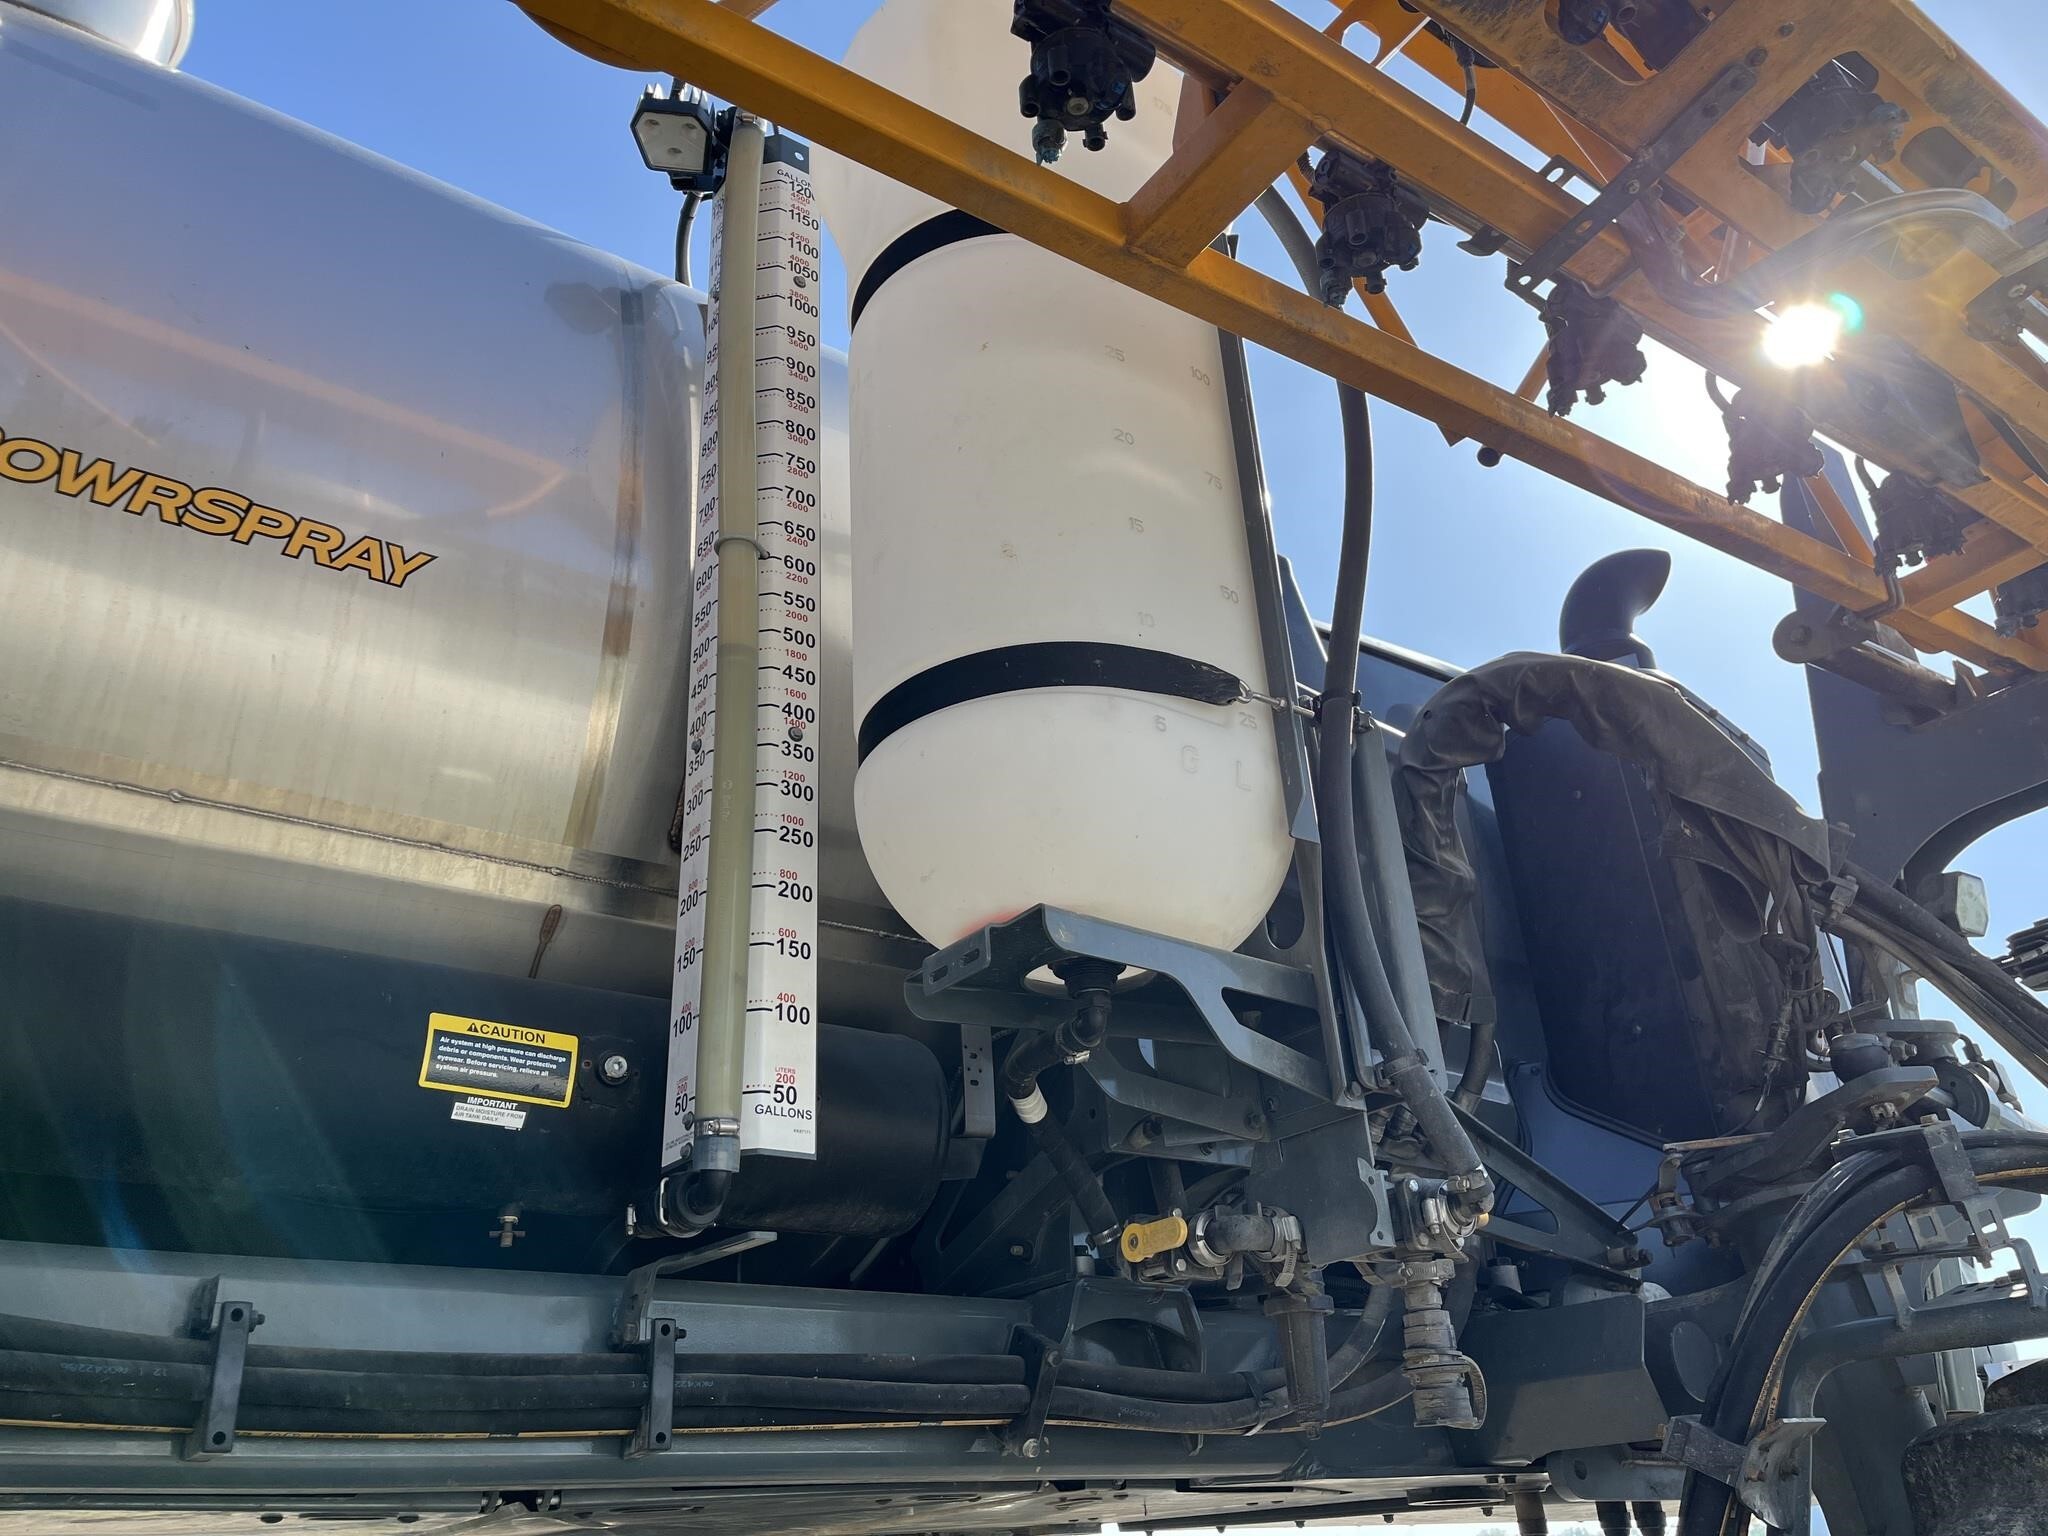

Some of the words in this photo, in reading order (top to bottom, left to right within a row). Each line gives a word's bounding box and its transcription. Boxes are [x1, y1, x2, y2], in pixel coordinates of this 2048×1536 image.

[789, 210, 819, 230] 1150
[788, 238, 818, 259] 1100
[790, 232, 810, 244] 4200
[788, 261, 818, 282] 1050
[789, 289, 809, 302] 3800
[787, 296, 818, 318] 1000
[786, 326, 816, 347] 950
[788, 338, 808, 351] 3600
[786, 357, 816, 378] 900
[788, 370, 808, 382] 3400
[786, 388, 816, 409] 850
[788, 401, 808, 414] 3200
[786, 420, 816, 441] 800
[788, 433, 808, 446] 3000
[1112, 428, 1136, 446] 20
[786, 452, 816, 474] 750
[787, 466, 808, 479] 2800
[700, 464, 716, 489] 750
[0, 425, 438, 588] OWRSPRAY
[785, 486, 816, 508] 700
[786, 500, 808, 512] 2600
[699, 497, 715, 523] 700
[784, 521, 816, 542] 650
[1128, 516, 1144, 535] 15
[698, 531, 714, 557] 650
[786, 534, 808, 548] 2400
[784, 555, 816, 576] 600
[696, 565, 712, 592] 600
[786, 572, 808, 584] 2200
[784, 591, 816, 612] 550
[694, 601, 712, 628] 550
[786, 610, 808, 622] 2000
[783, 627, 816, 648] 500
[693, 637, 710, 664] 500
[785, 649, 807, 662] 1800
[782, 665, 816, 686] 450
[691, 674, 708, 699] 450
[784, 688, 807, 700] 1600
[690, 711, 706, 736] 400
[782, 702, 815, 724] 400
[784, 717, 806, 730] 1400
[781, 741, 814, 762] 350
[688, 750, 706, 776] 350
[783, 770, 806, 783] 1200
[780, 780, 814, 802] 300
[686, 789, 704, 816] 300
[781, 814, 804, 826] 1000
[779, 826, 814, 848] 250
[683, 834, 701, 862] 250
[780, 869, 798, 880] 800
[778, 880, 812, 902] 200
[680, 890, 698, 918] 200
[778, 928, 796, 939] 600
[776, 938, 812, 960] 150
[676, 947, 696, 973] 150
[776, 992, 796, 1004] 400
[775, 1003, 810, 1025] 100
[480, 1024, 546, 1044] CAUTION
[673, 1012, 692, 1038] 100
[438, 1046, 460, 1054] debris
[526, 1060, 556, 1069] protective
[451, 1038, 474, 1046] system
[497, 1046, 524, 1056] pressure
[537, 1052, 566, 1062] discharge
[436, 1064, 459, 1072] system
[466, 1058, 488, 1066] Before
[776, 1074, 796, 1085] 200
[467, 1096, 518, 1110] IMPORTANT
[674, 1093, 688, 1116] 50
[773, 1085, 797, 1105] 50
[475, 1108, 505, 1116] MOISTURE
[754, 1104, 812, 1120] GALLONS
